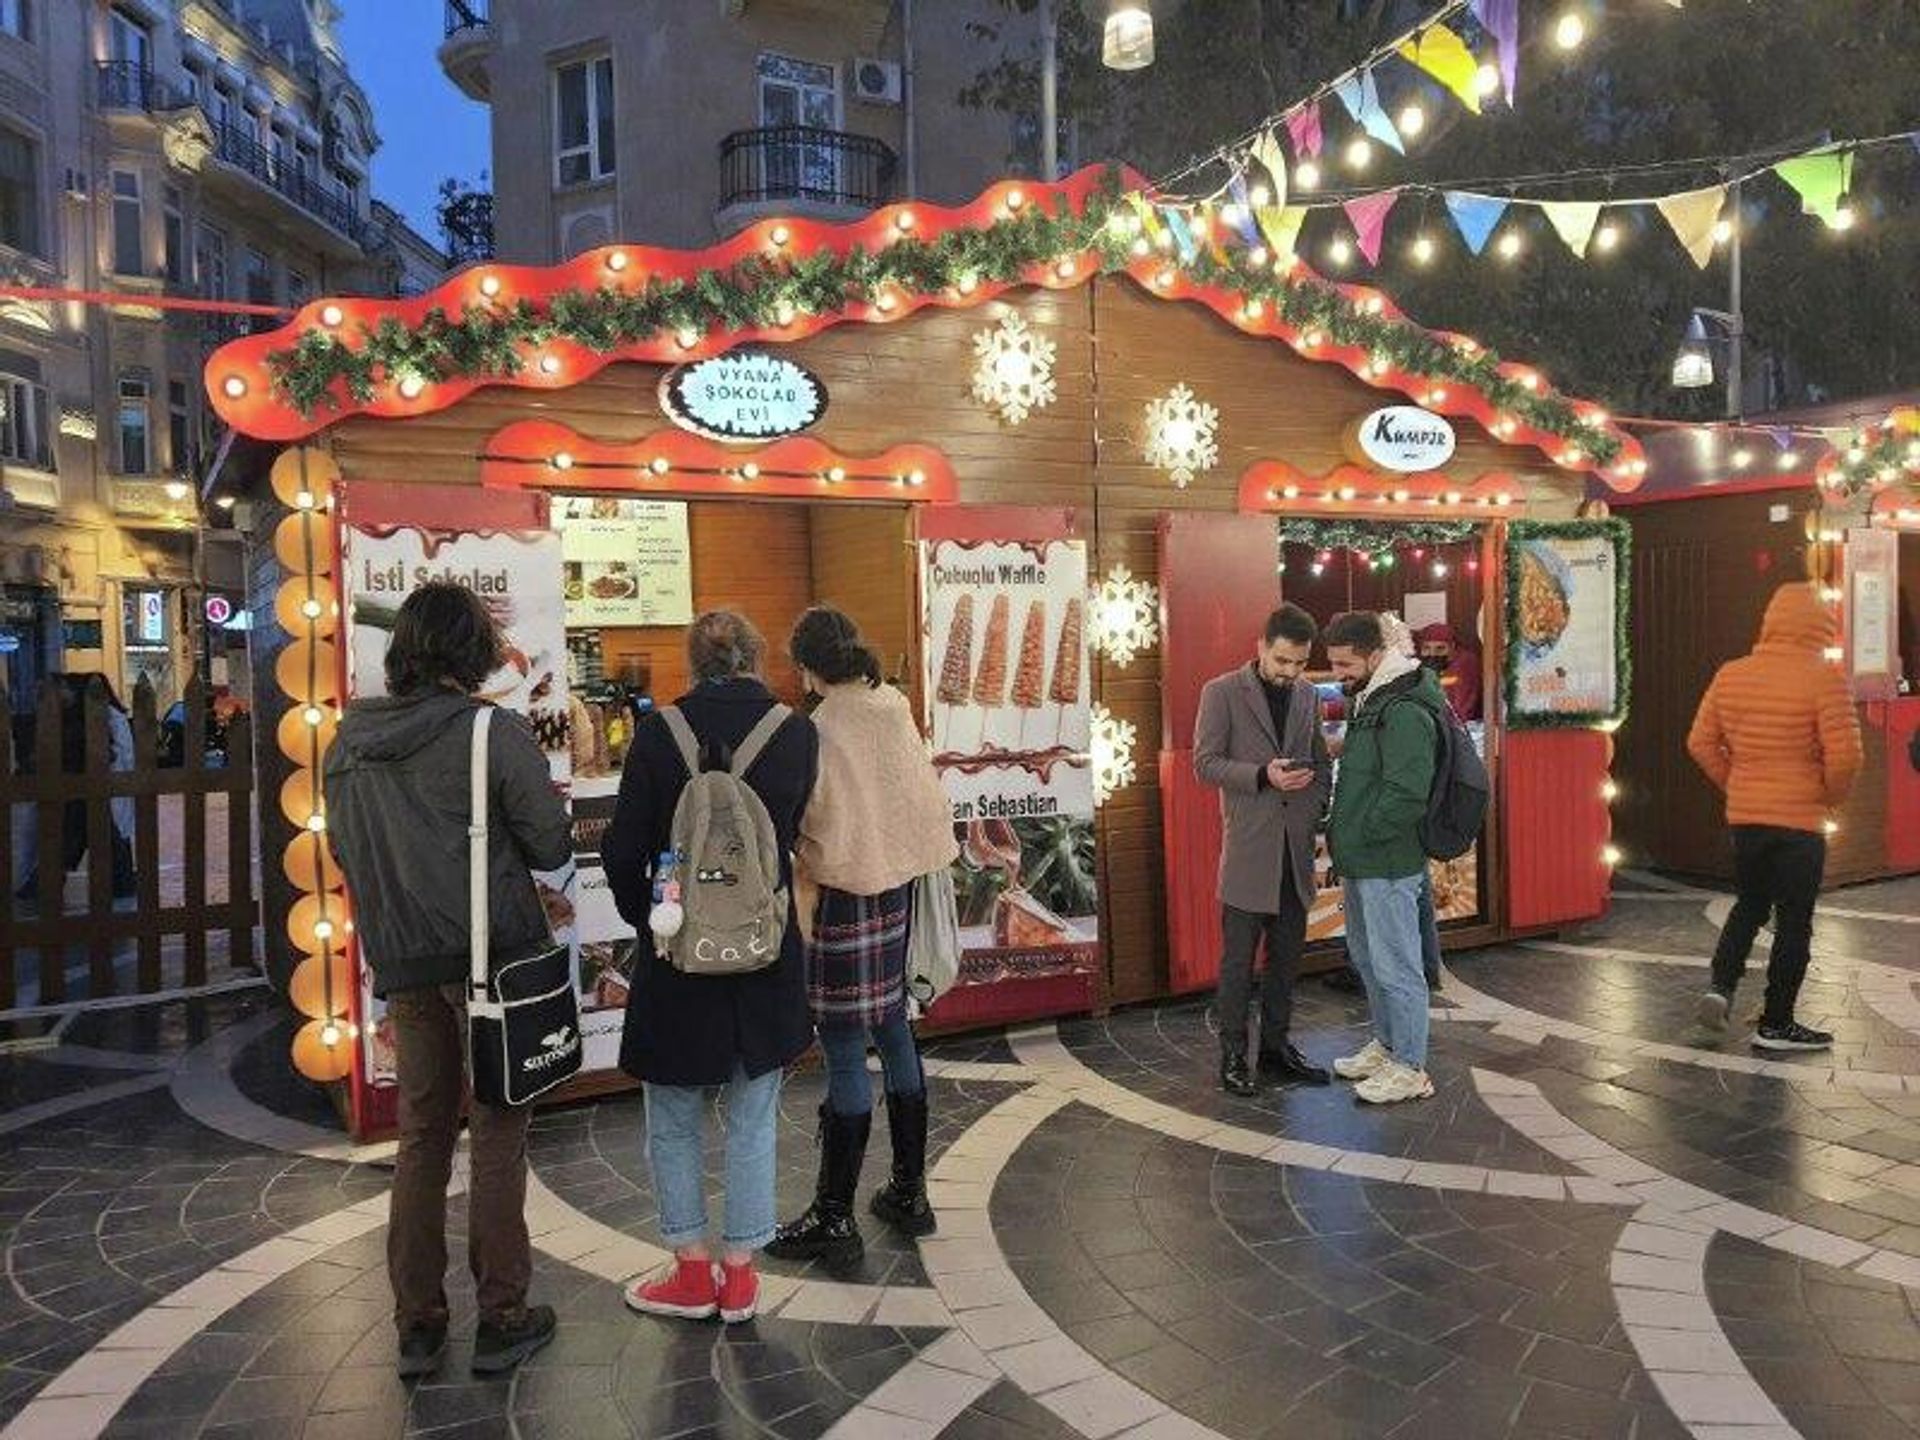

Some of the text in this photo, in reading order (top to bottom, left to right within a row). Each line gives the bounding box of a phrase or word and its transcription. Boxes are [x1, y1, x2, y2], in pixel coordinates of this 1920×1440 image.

[718, 367, 782, 384] VYANA
[998, 564, 1046, 585] Waffle
[977, 792, 1058, 818] Sebastian
[695, 918, 770, 961] Cat
